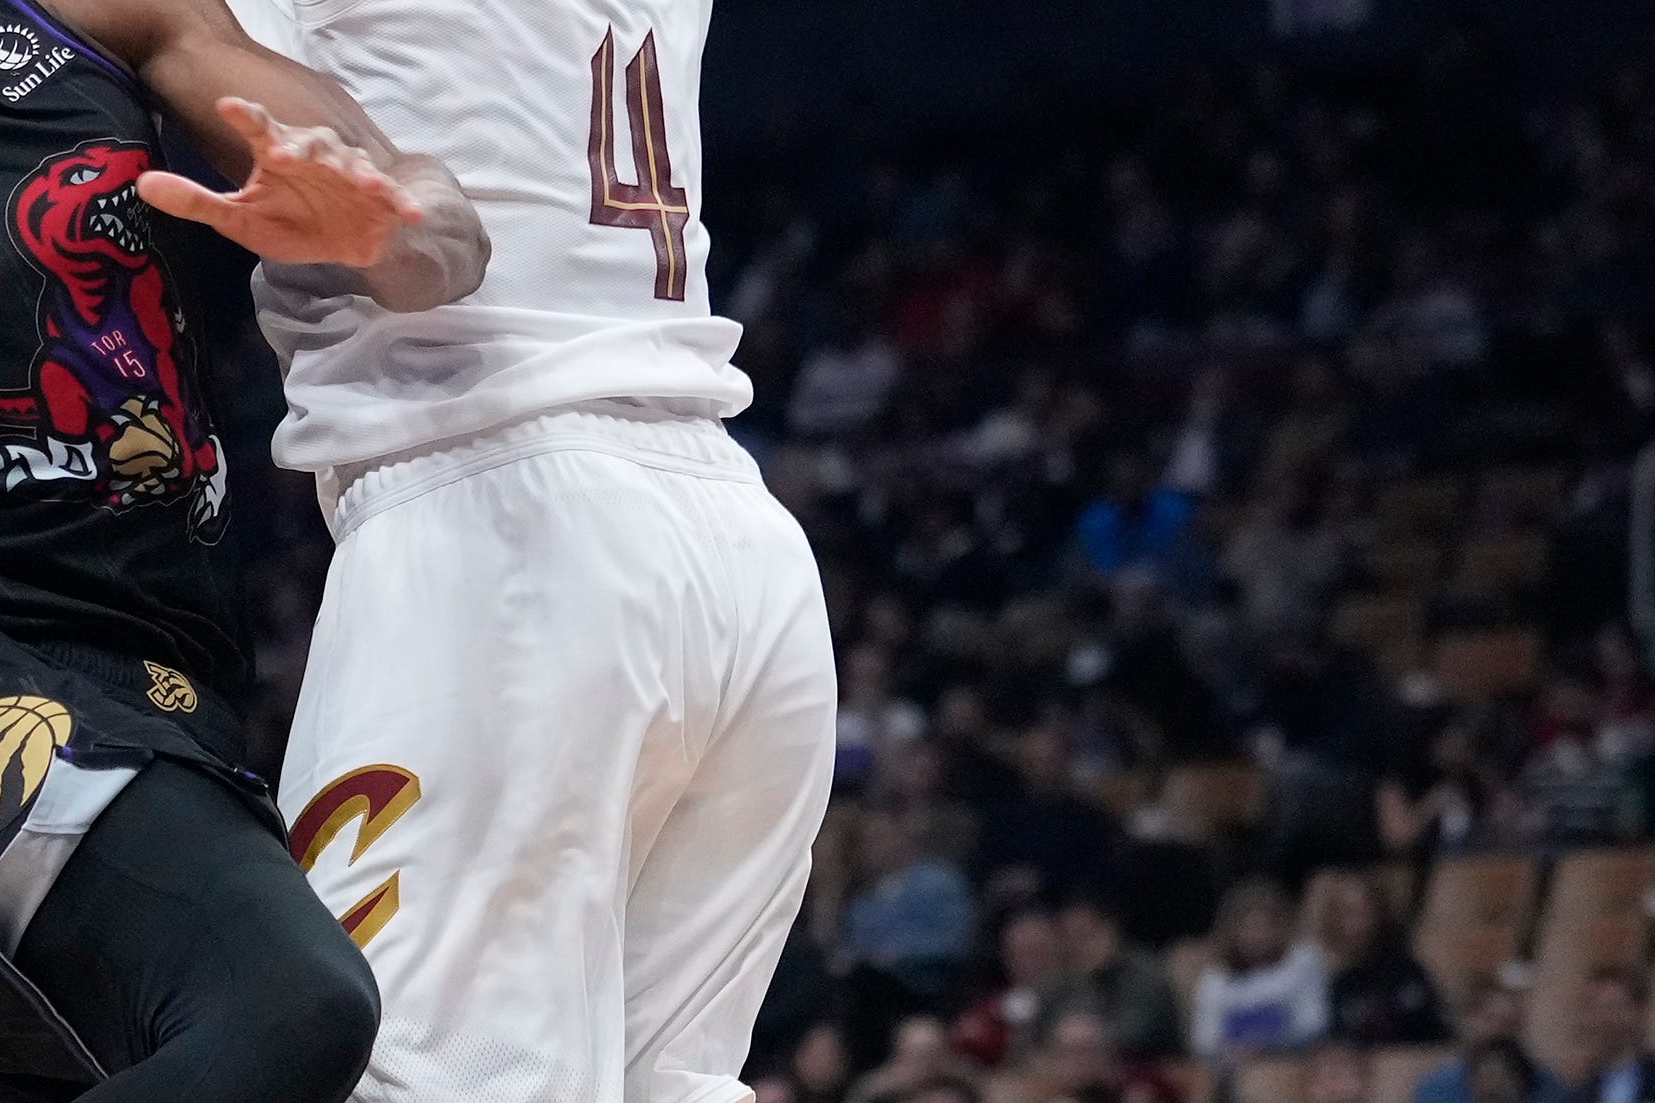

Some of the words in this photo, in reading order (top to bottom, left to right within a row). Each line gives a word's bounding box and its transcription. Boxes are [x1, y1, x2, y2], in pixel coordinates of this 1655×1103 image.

[2, 73, 43, 102] Sun
[34, 46, 76, 78] Life
[587, 22, 690, 302] 4
[90, 329, 127, 356] TOR
[113, 349, 146, 378] 15
